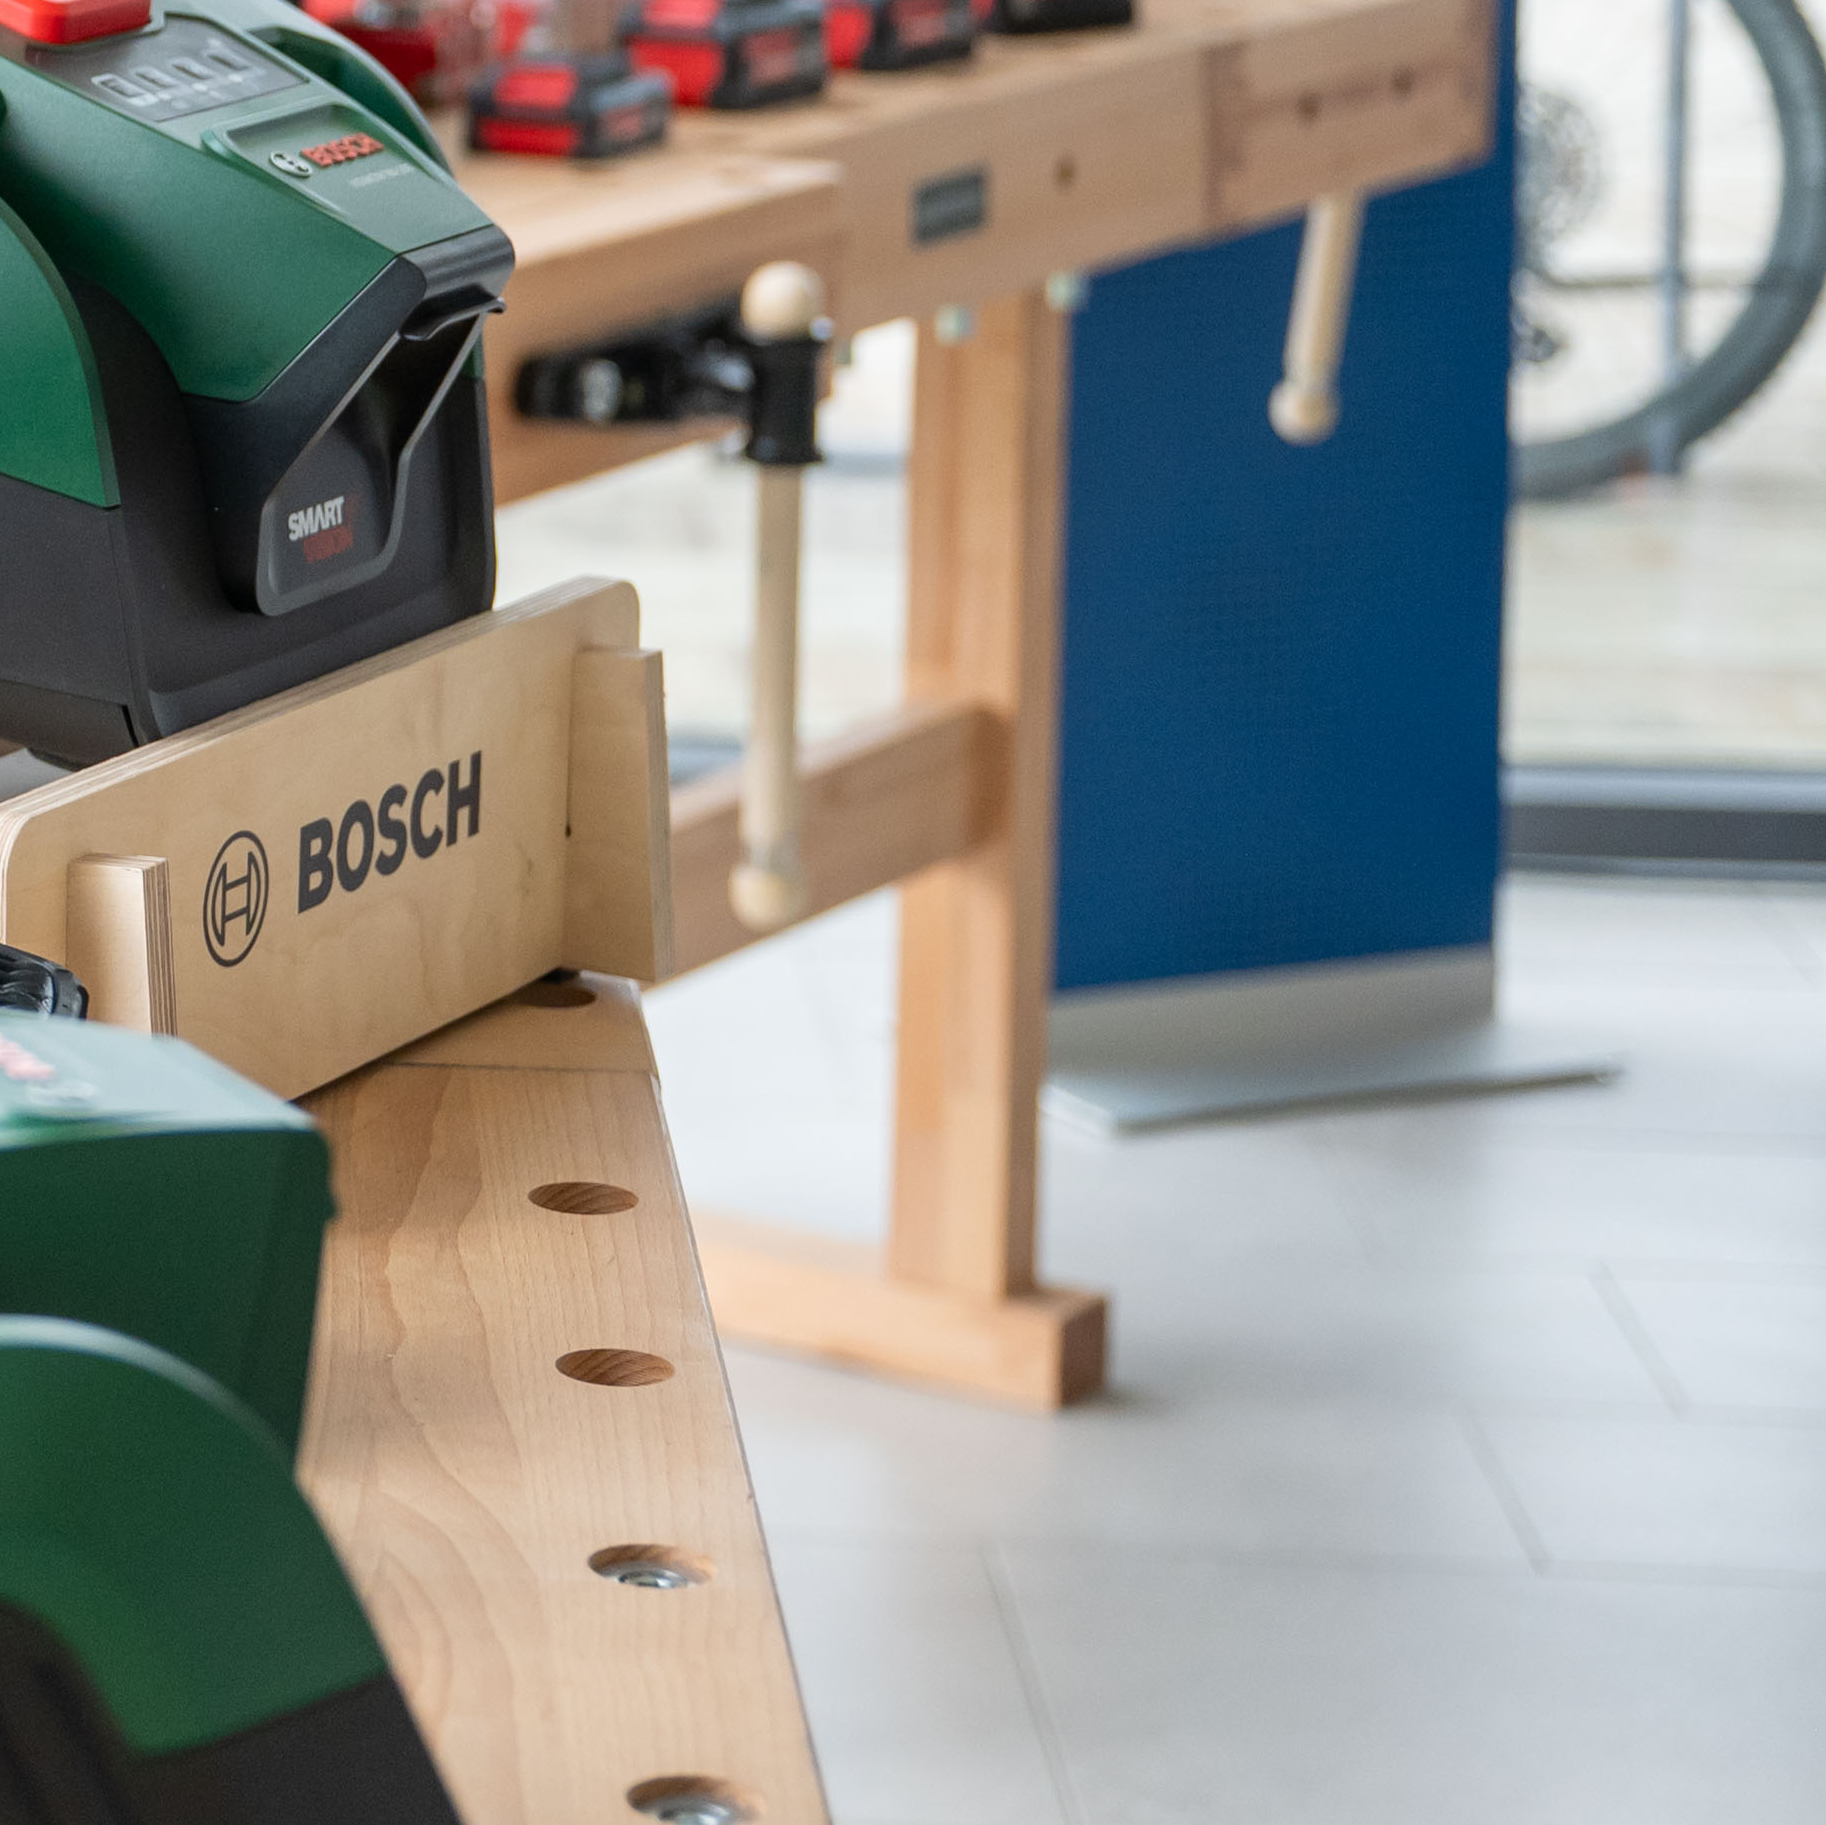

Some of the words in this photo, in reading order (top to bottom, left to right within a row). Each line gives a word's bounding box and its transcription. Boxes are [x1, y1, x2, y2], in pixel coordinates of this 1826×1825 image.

[301, 131, 385, 167] BOSCH
[288, 495, 345, 542] SMART
[298, 750, 482, 914] BOSCH
